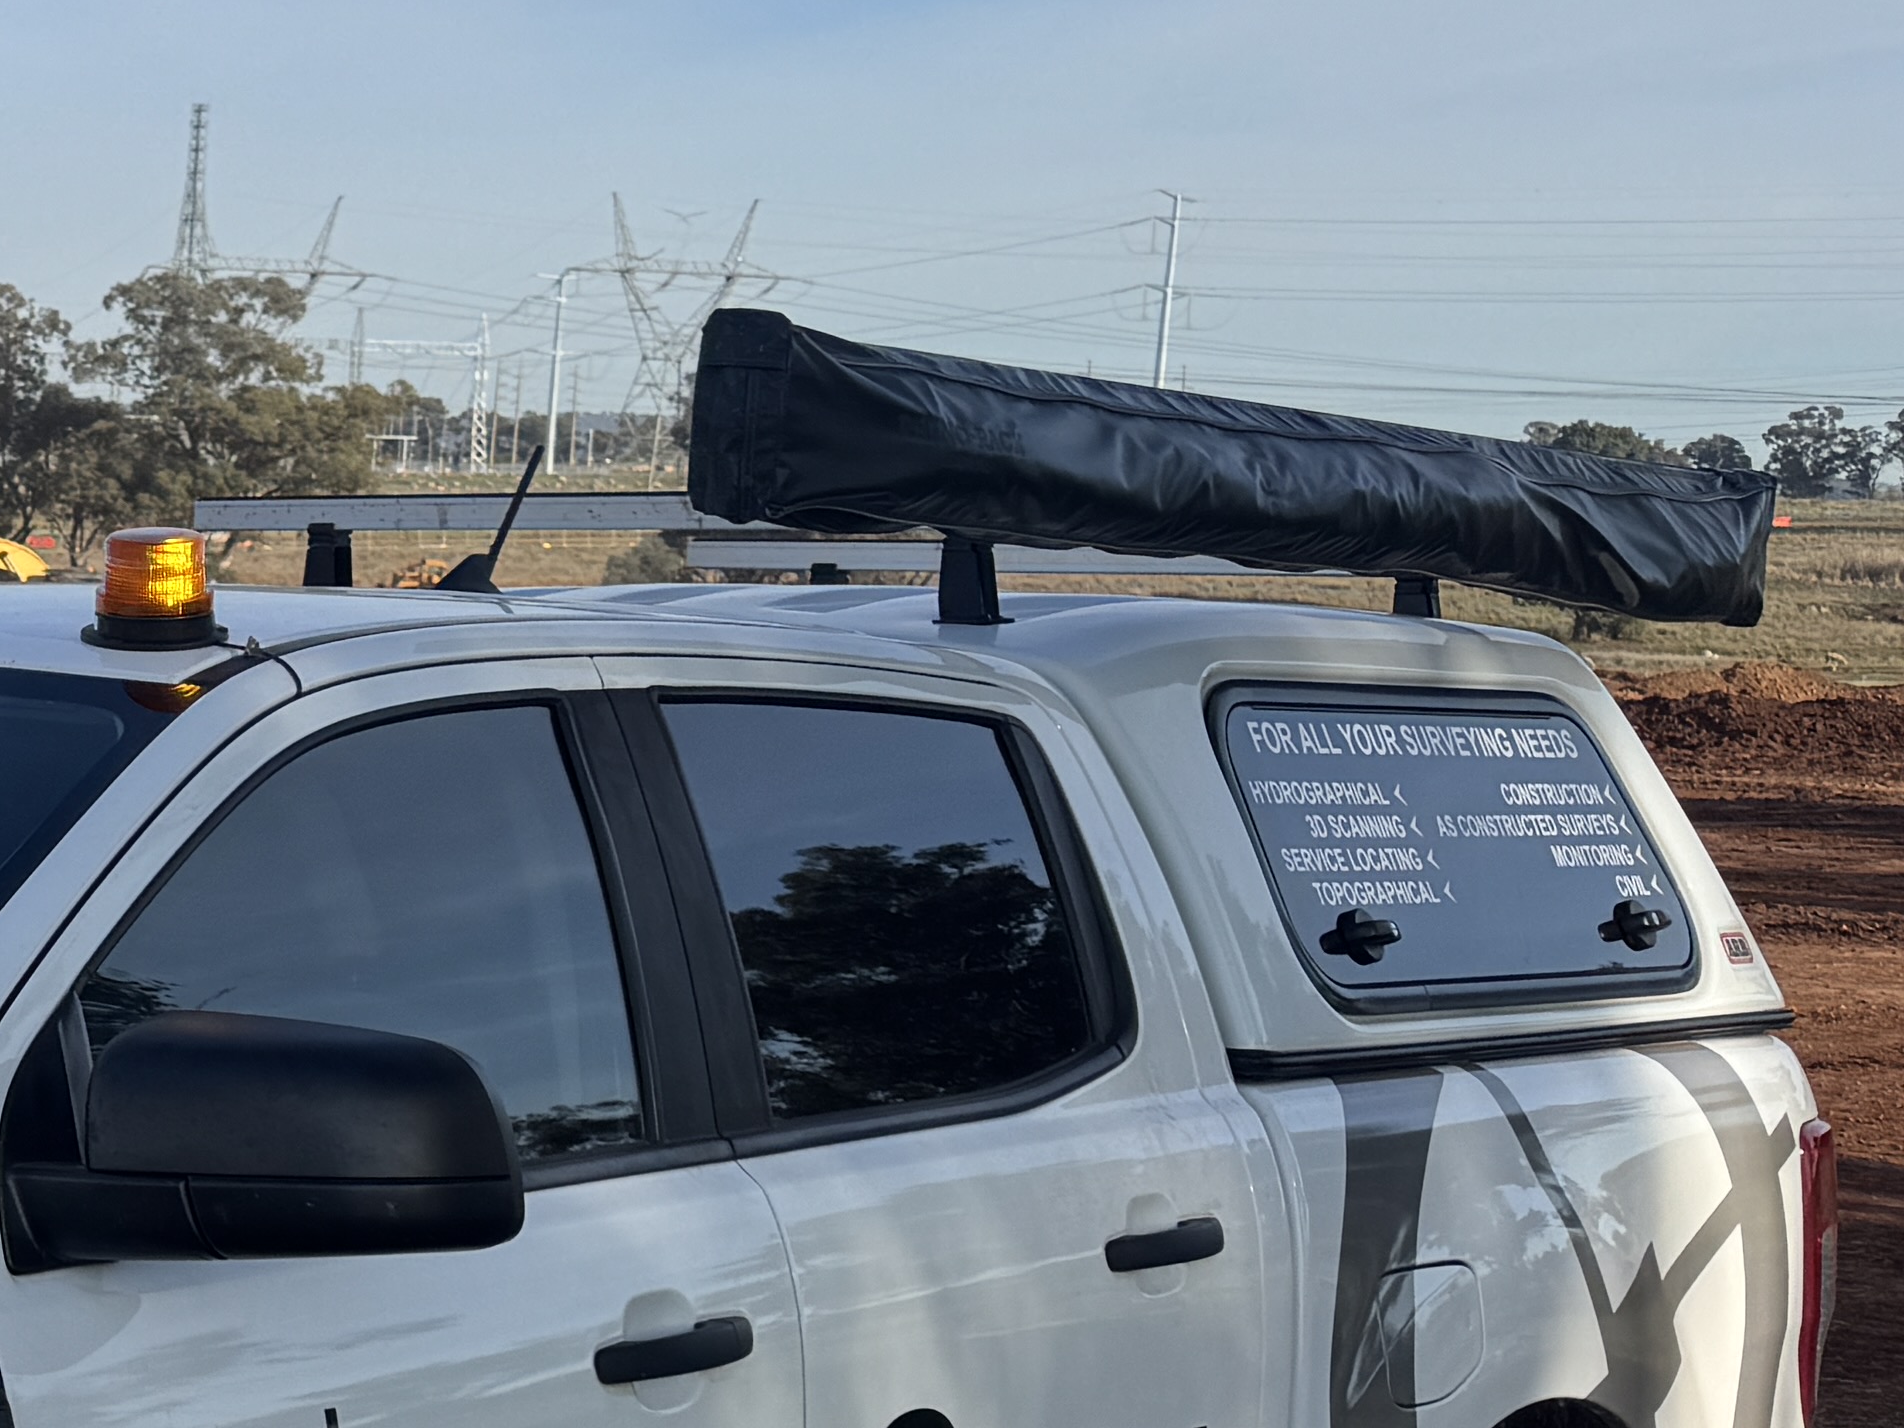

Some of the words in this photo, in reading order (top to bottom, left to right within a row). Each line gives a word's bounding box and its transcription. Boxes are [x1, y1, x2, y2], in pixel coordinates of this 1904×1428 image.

[1246, 721, 1299, 755] FOR
[1298, 723, 1343, 755] ALL
[1337, 723, 1403, 756] YOUR
[1399, 725, 1514, 758] SURVEYING
[1511, 728, 1579, 759] NEEDS
[1248, 780, 1390, 806] HYDROGRAPHICAL
[1500, 783, 1604, 806] CONSTRUCTION
[1305, 814, 1328, 839] 3D
[1327, 814, 1407, 839] SCANNING
[1436, 815, 1458, 838] AS
[1457, 814, 1558, 838] CONSTRUCTED
[1557, 814, 1620, 837] SURVEYS
[1281, 848, 1349, 872] SERVICE
[1346, 848, 1424, 872] LOCATING
[1550, 844, 1635, 868] MONITORING
[1312, 881, 1441, 907] TOPOGRAPHICAL
[1616, 875, 1651, 898] CIVIL
